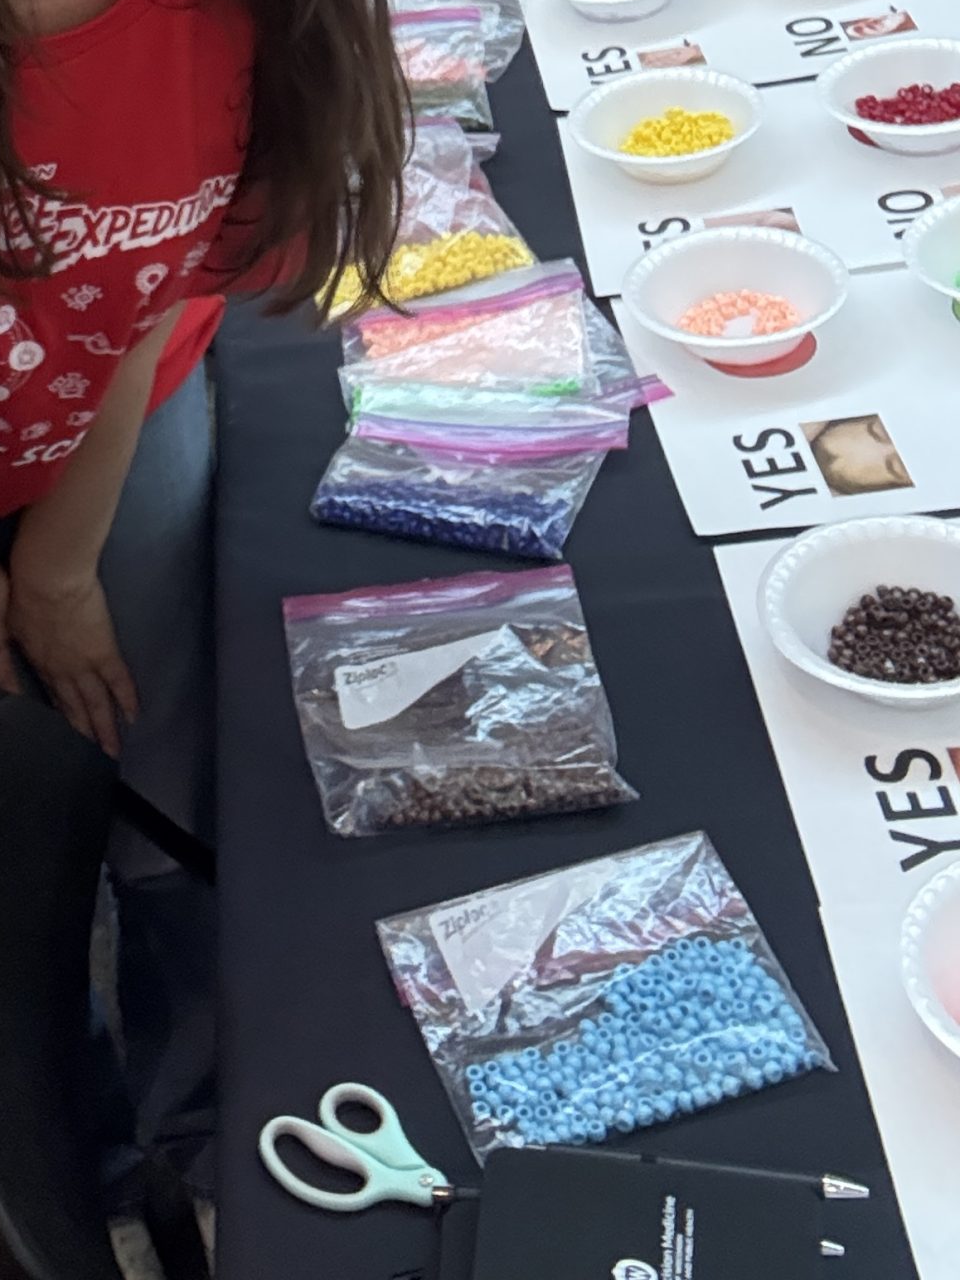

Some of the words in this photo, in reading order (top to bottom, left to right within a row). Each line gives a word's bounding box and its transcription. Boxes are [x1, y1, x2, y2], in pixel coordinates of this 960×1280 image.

[785, 16, 848, 58] NO
[581, 45, 632, 86] ES
[733, 427, 818, 511] YES
[864, 748, 960, 873] YES
[660, 1195, 676, 1248] Medicine
